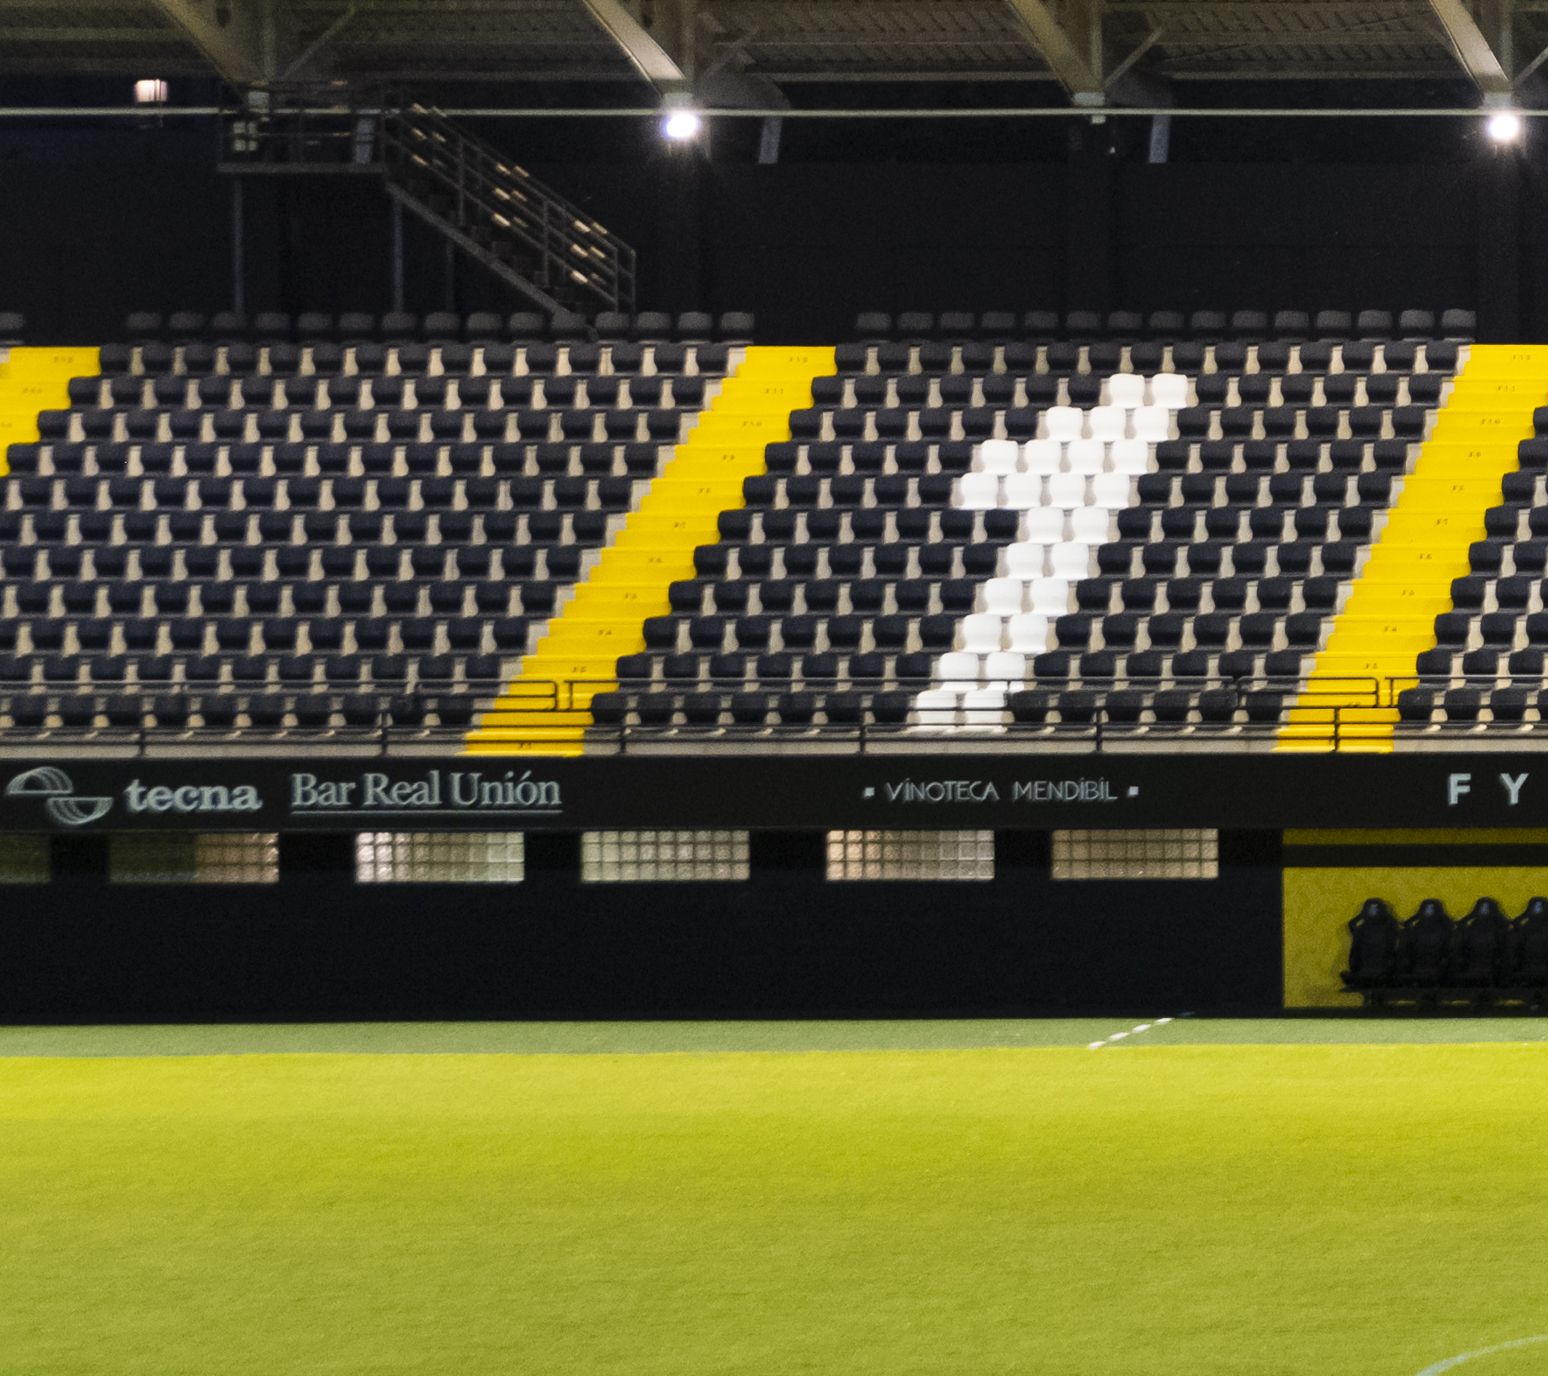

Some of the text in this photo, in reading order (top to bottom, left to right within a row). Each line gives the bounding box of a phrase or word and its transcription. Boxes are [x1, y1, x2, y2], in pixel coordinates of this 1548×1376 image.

[914, 372, 1190, 733] 1
[125, 780, 262, 811] tecna
[292, 770, 561, 806] Bar Real Unión
